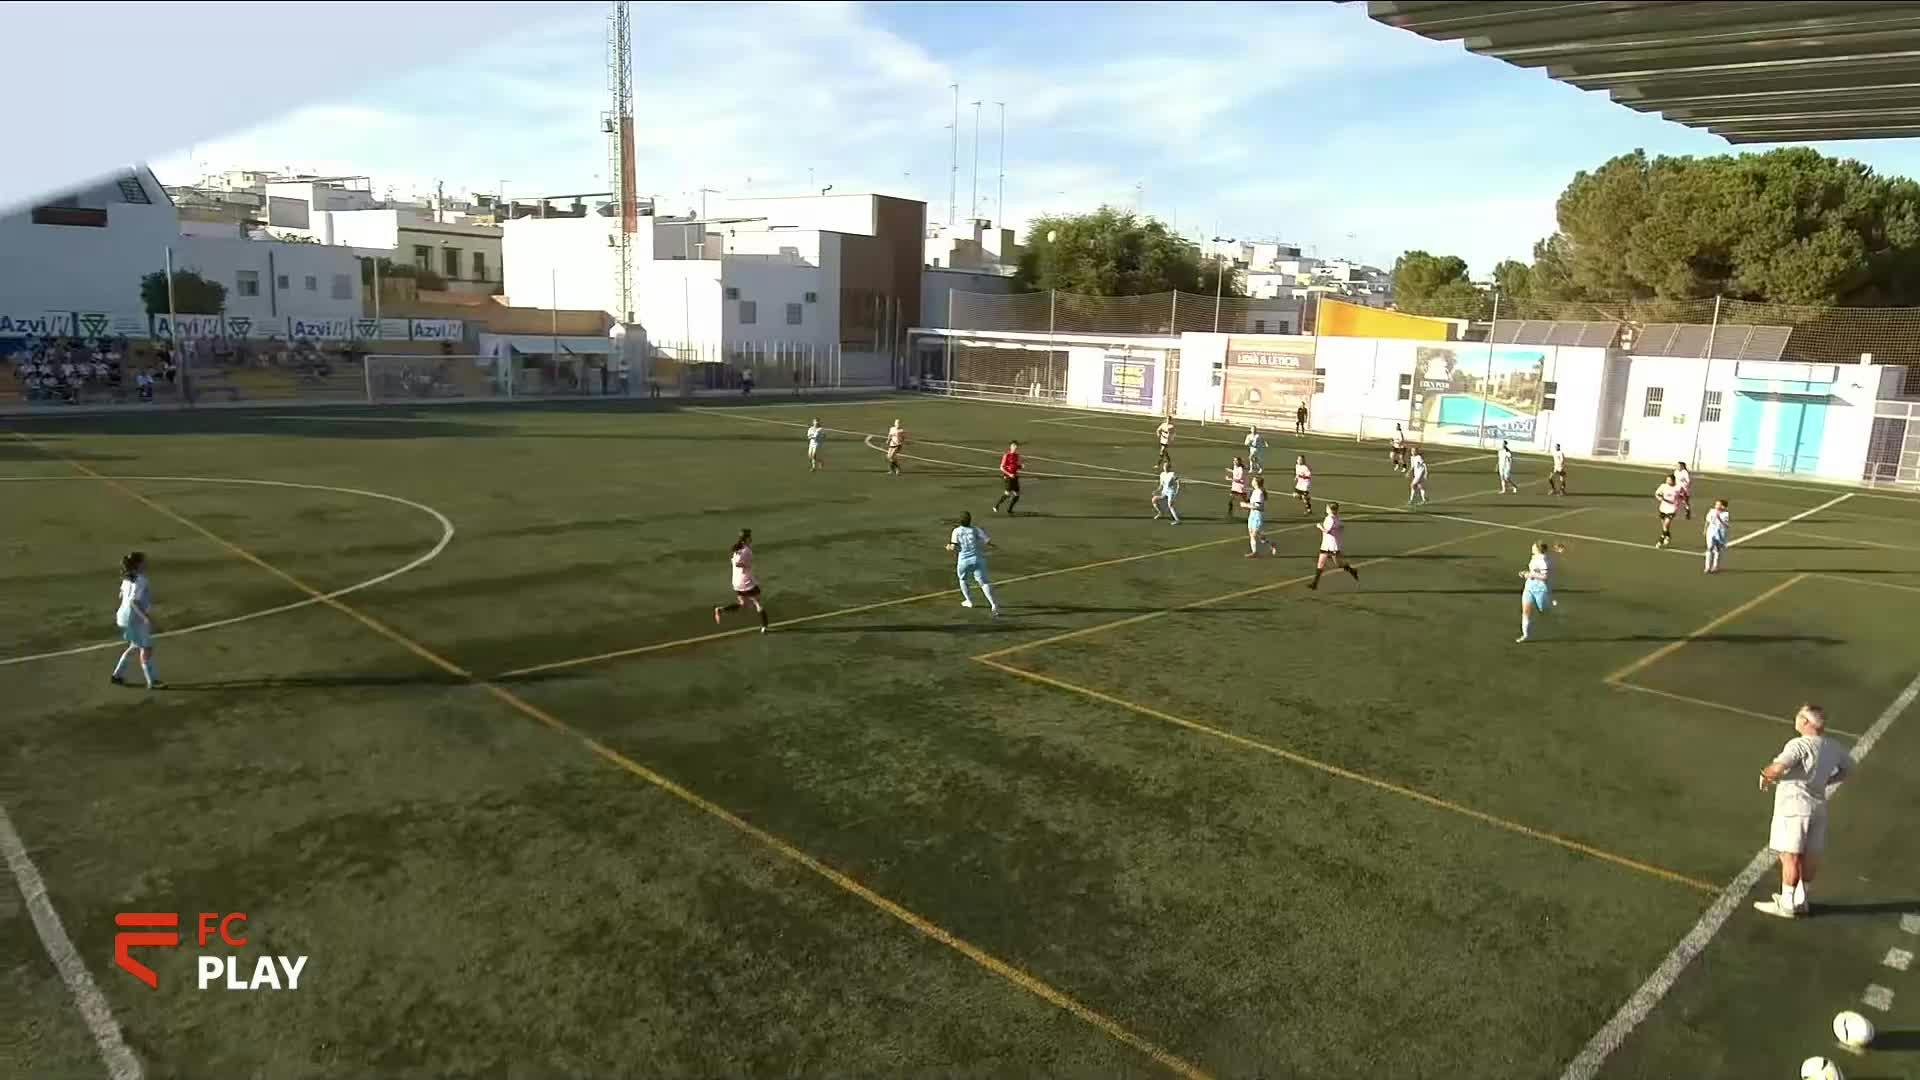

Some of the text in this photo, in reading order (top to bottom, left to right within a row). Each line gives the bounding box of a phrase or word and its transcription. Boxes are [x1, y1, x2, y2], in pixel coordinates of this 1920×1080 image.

[0, 315, 46, 333] Azvi
[294, 320, 331, 336] Azvi
[415, 322, 446, 337] Azvi
